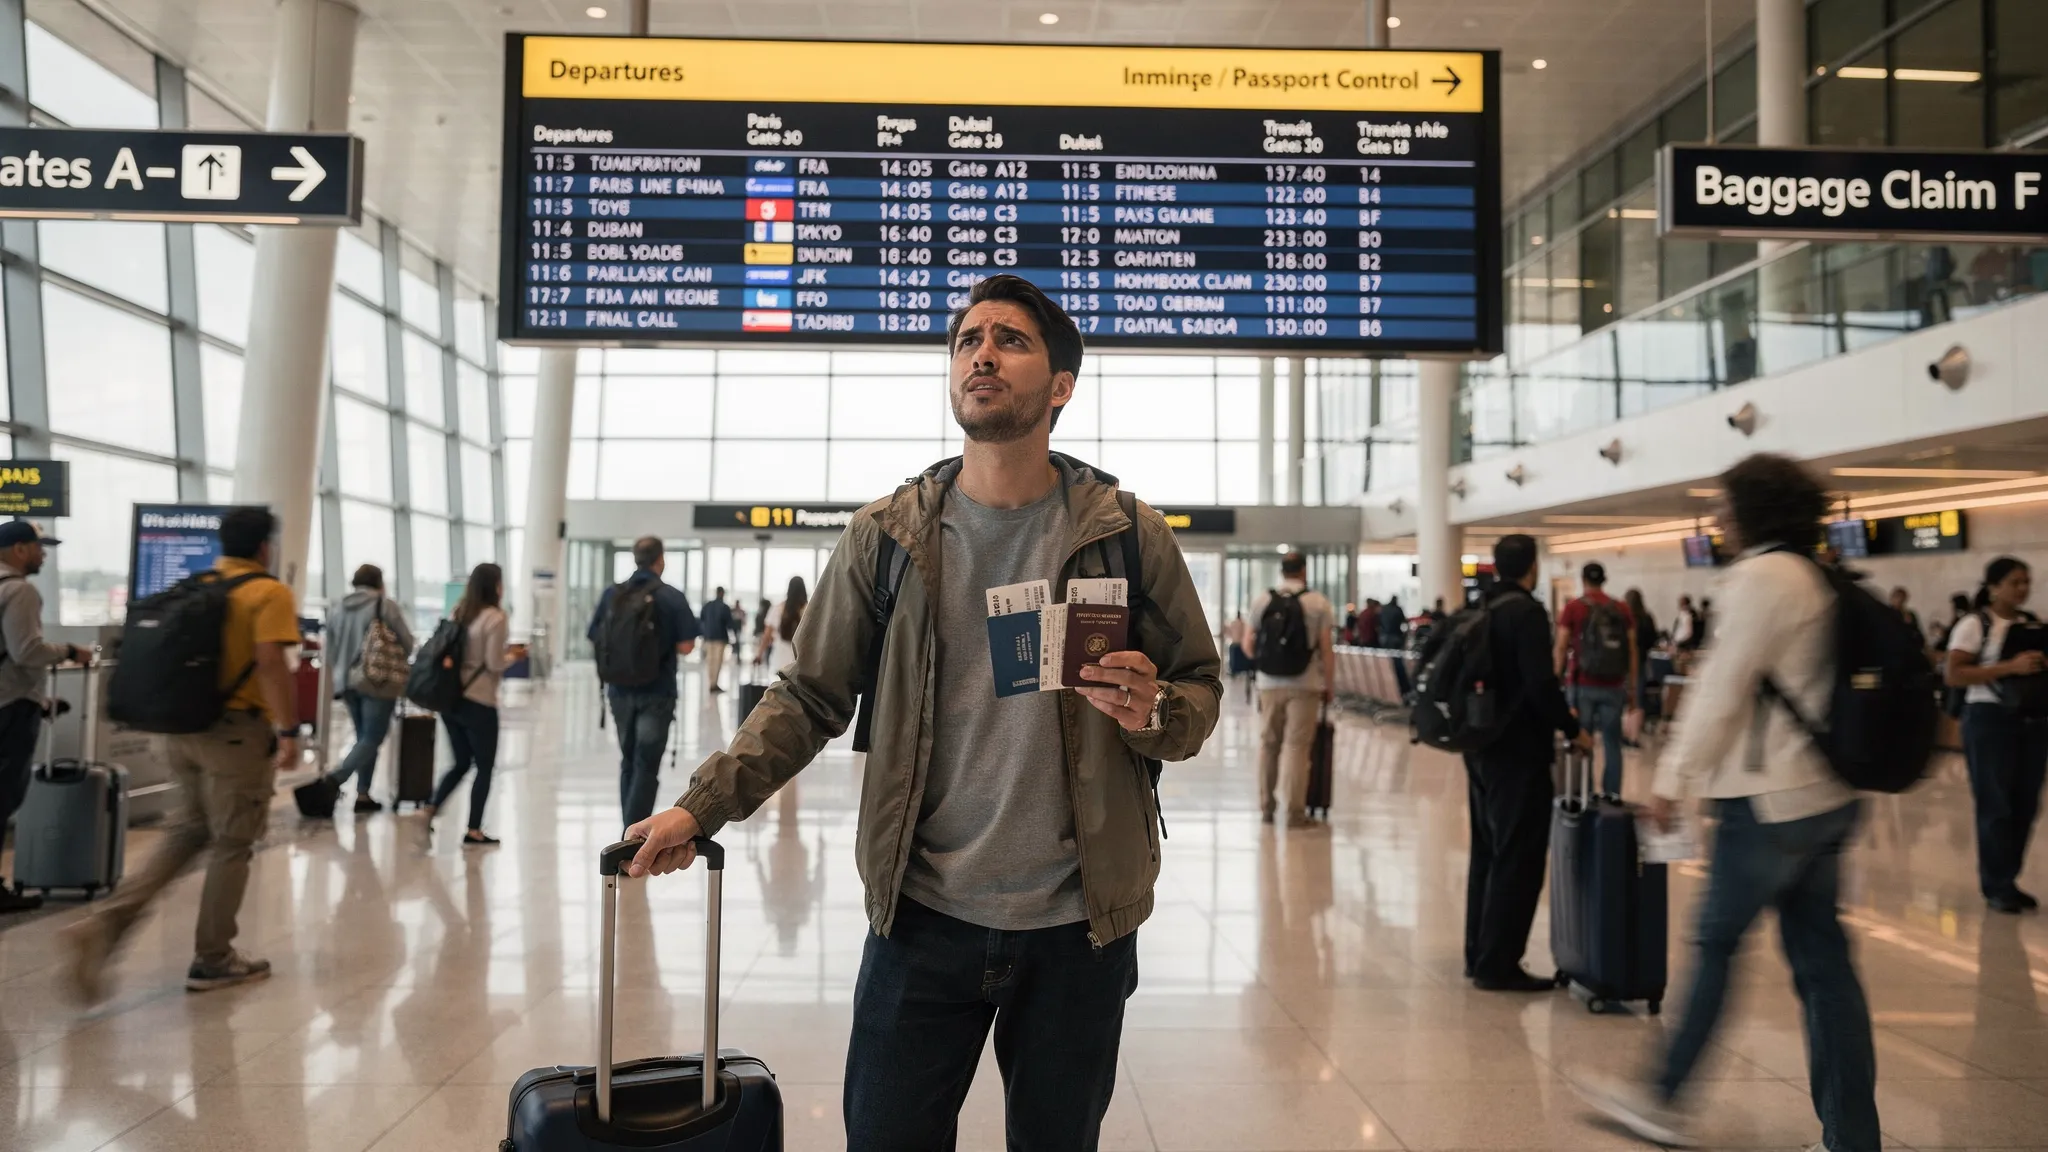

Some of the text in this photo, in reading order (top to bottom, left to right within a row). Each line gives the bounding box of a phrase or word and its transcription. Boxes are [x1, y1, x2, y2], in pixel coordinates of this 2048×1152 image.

[551, 60, 684, 84] Departures
[1234, 68, 1329, 92] Passport
[1336, 70, 1419, 90] Control
[534, 125, 614, 145] Departures
[0, 149, 92, 189] ates
[534, 155, 576, 171] 11:5
[799, 158, 829, 175] FRA
[880, 160, 932, 177] 14:05
[948, 161, 988, 177] Gate
[994, 161, 1028, 178] A12
[1062, 162, 1101, 179] 11:5
[1360, 167, 1381, 183] 14
[533, 176, 574, 193] 11:7
[589, 177, 634, 194] PARIS
[799, 180, 830, 197] FRA
[880, 181, 932, 199] 14:05
[948, 182, 987, 199] Gate
[994, 183, 1028, 200] A12
[1062, 183, 1100, 200] 11:5
[1265, 186, 1326, 204] 122:00
[1695, 165, 2041, 216] Baggage Claim F
[533, 198, 574, 215] 11:5
[879, 203, 932, 220] 14:05
[948, 204, 987, 221] Gate
[994, 204, 1018, 222] C3
[1061, 206, 1100, 222] 11:5
[1265, 208, 1327, 225] 123:40
[532, 220, 573, 237] 11:4
[879, 225, 932, 242] 16:40
[947, 226, 987, 243] Gate
[994, 226, 1018, 244] C3
[1264, 230, 1327, 247] 233:00
[532, 242, 573, 259] 11:5
[947, 248, 987, 266] Gate
[994, 249, 1018, 266] C3
[1060, 249, 1100, 267] 12:5
[530, 264, 572, 281] 11:6
[879, 269, 931, 287] 14:42
[1060, 271, 1100, 289] 15:5
[1264, 274, 1327, 292] 230:00
[879, 291, 931, 309] 16:20
[529, 309, 568, 327] 12:1
[585, 310, 633, 327] FINAL
[637, 311, 679, 328] CALL
